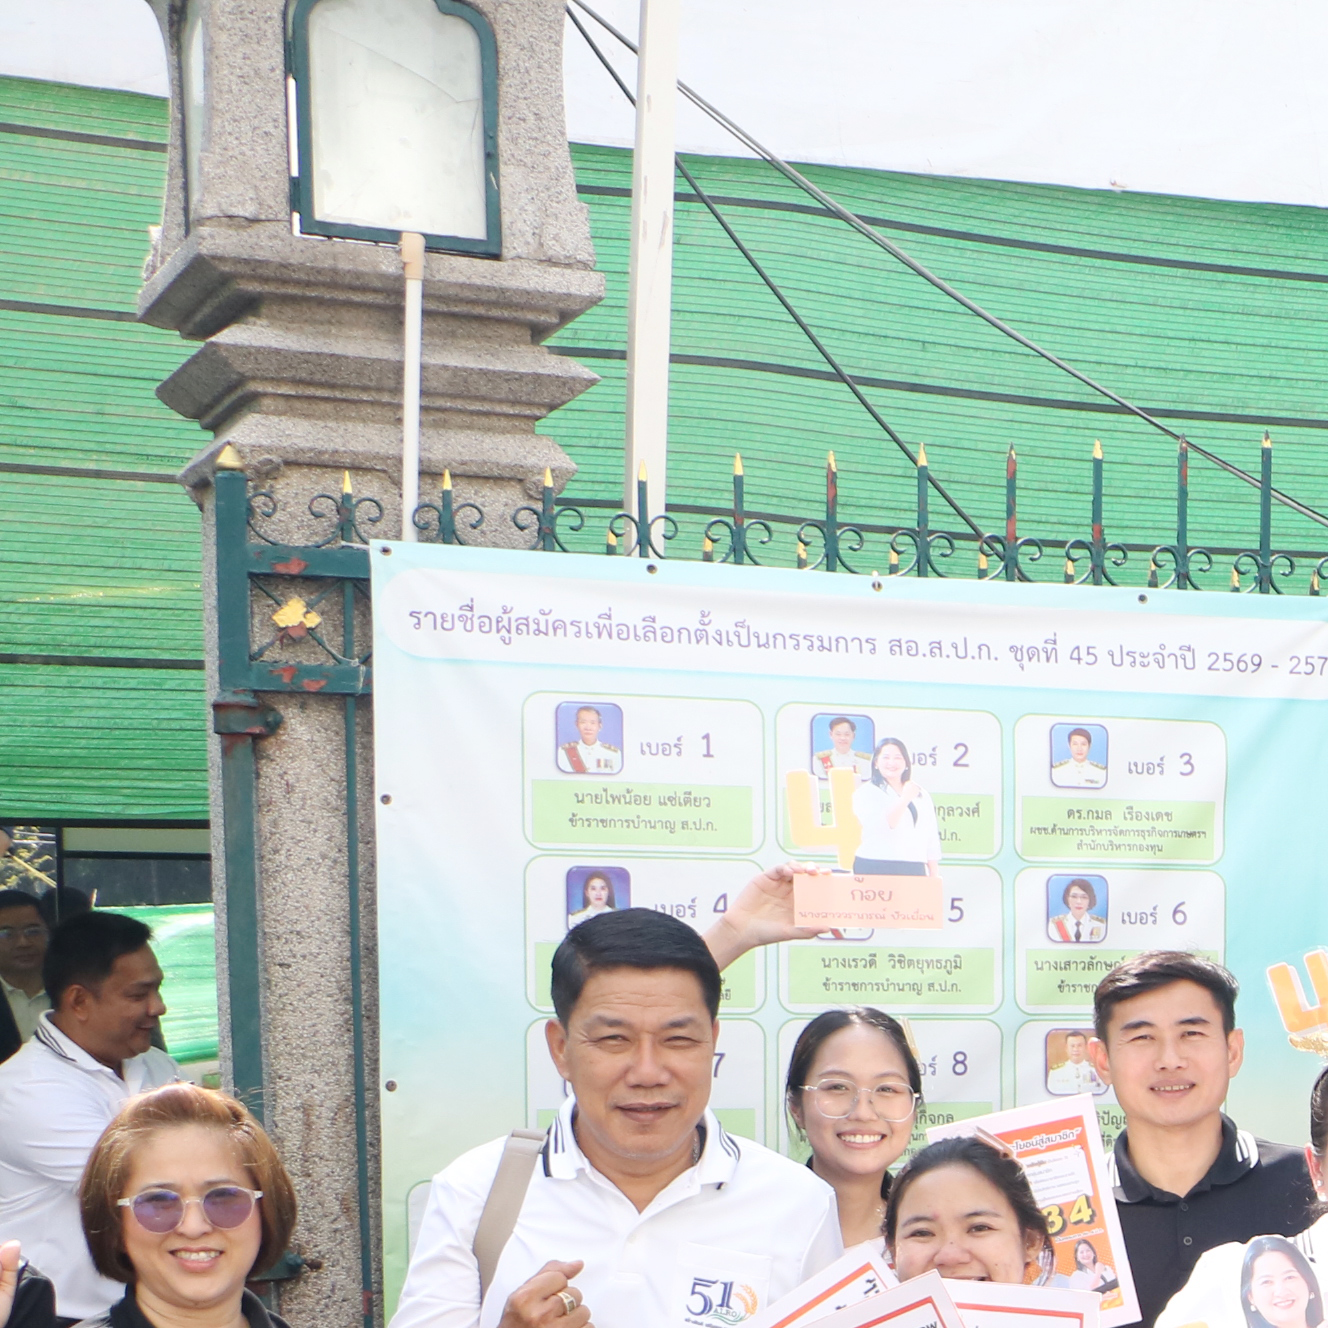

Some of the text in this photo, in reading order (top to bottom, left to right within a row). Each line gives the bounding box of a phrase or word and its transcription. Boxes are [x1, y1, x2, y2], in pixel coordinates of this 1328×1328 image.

[408, 597, 876, 656] รายชื่อผู้สมัครเพื่อเลือกตั้งเป็นกรรมการ
[889, 637, 999, 662] สอ.ส.ป.ก.
[1009, 632, 1058, 672] ชุดที่
[1070, 645, 1097, 666] 45
[1108, 645, 1196, 671] ประจำปี
[1207, 653, 1262, 674] 2569
[640, 733, 714, 758] เบอร์ 1
[953, 743, 969, 767] 2
[1128, 752, 1195, 776] เบอร์ 3
[569, 812, 676, 833] ข้าราชการบำนาญ
[1067, 809, 1112, 820] ดร.กมล
[948, 898, 964, 922] 5
[1121, 901, 1187, 925] เบอร์ 6
[823, 977, 961, 995] ข้าราชการบำนาญ ส.ป.ก.
[952, 1051, 967, 1076] 8
[1070, 1194, 1095, 1226] 4
